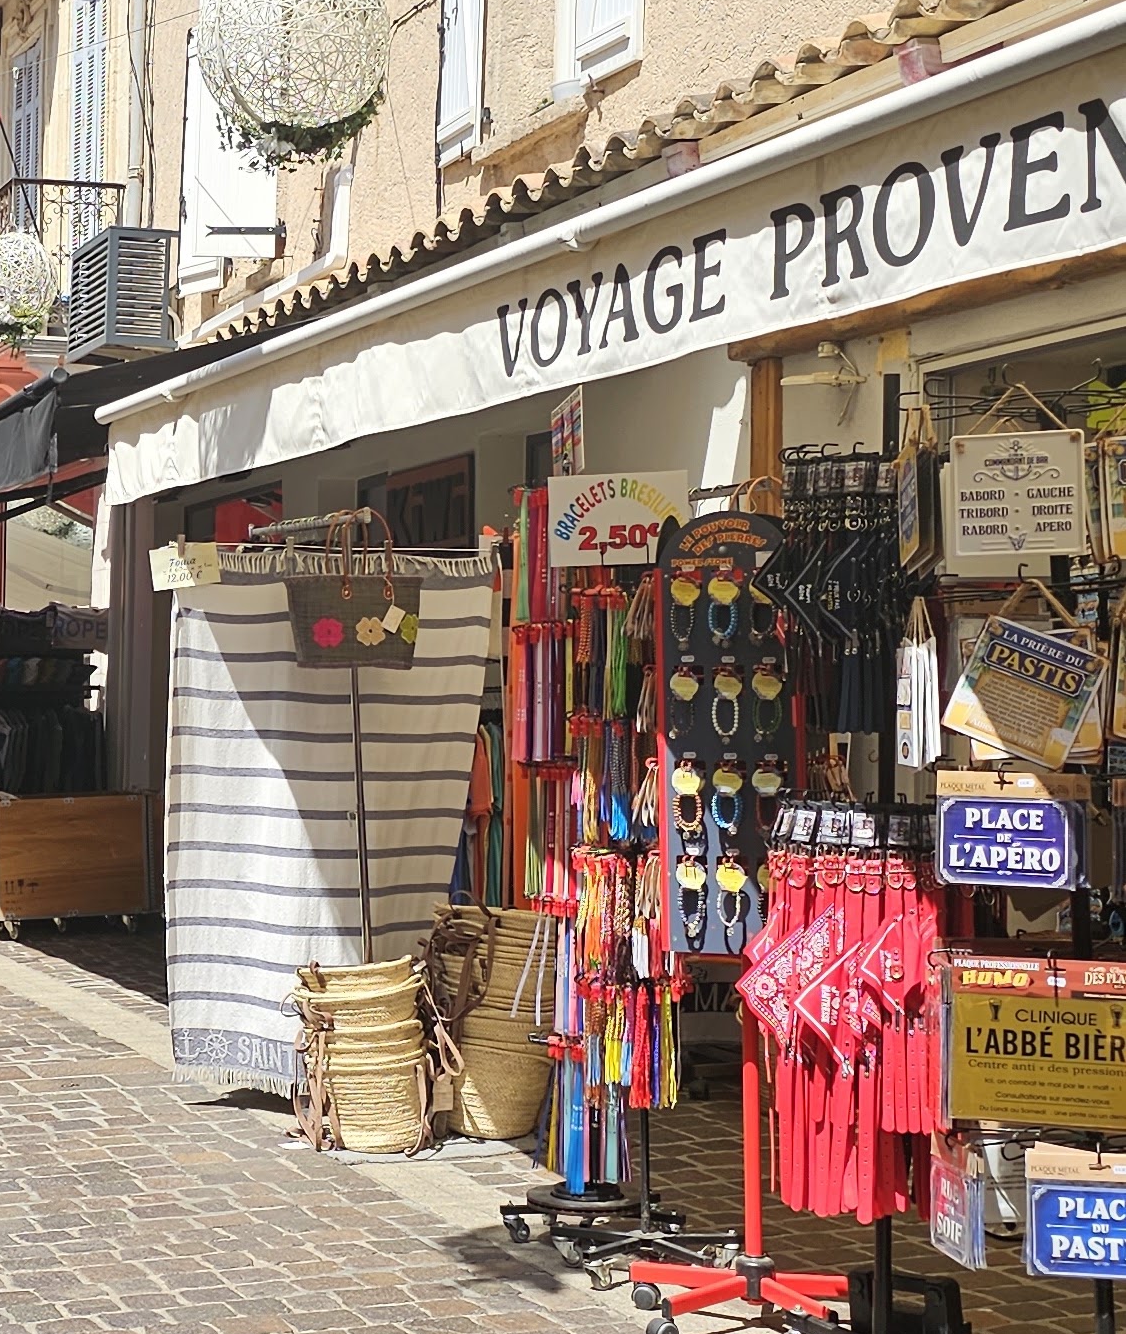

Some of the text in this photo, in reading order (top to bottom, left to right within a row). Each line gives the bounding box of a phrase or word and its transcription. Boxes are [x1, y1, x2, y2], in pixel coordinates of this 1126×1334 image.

[496, 229, 727, 378] VOYAGE
[960, 489, 1005, 502] BABORD
[1027, 486, 1074, 499] GAUCHE
[554, 478, 617, 542] BRACELETS
[959, 507, 1009, 519] TRIBORD
[1032, 504, 1073, 516] DROITE
[679, 518, 750, 552] LE POUVOIR
[962, 524, 1008, 536] RABORD
[1035, 521, 1072, 532] APERO
[692, 532, 767, 556] DES PIERRES
[1002, 629, 1084, 667] LA PRIÈRE DU
[989, 644, 1079, 693] PASTIS
[965, 807, 1044, 831] PLACE
[996, 833, 1012, 843] DE
[948, 842, 1061, 871] L'APÉRO
[1084, 971, 1105, 986] DES
[1015, 1008, 1097, 1026] CLINIQUE
[966, 1026, 1054, 1058] L'ABBÉ
[237, 1036, 295, 1076] SAINT
[968, 1059, 1008, 1070] Centre
[1012, 1061, 1036, 1072] anti
[1048, 1064, 1069, 1074] des
[995, 1091, 1047, 1101] Consultations
[1062, 1096, 1110, 1106] rendez-vous
[1058, 1196, 1126, 1221] PLAC
[936, 1211, 963, 1246] SOIF
[1092, 1223, 1110, 1234] DU
[1050, 1234, 1126, 1261] PAST
